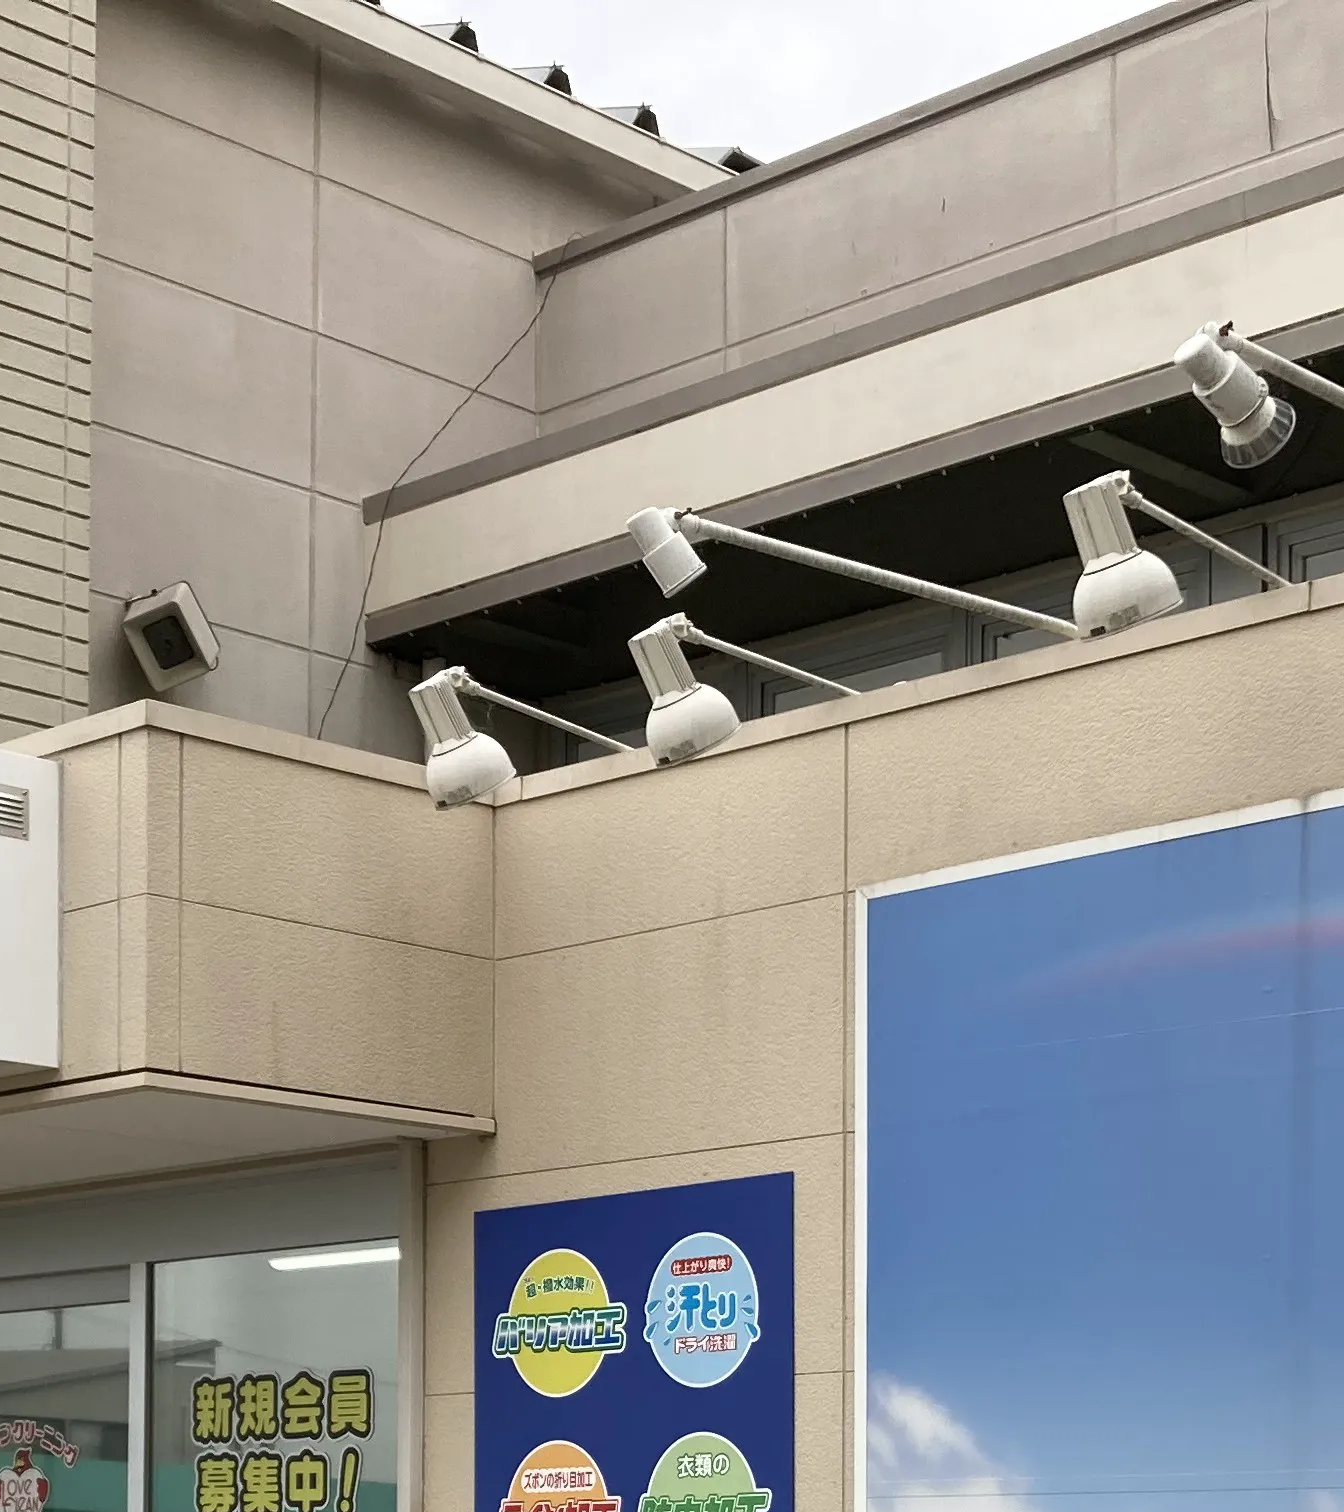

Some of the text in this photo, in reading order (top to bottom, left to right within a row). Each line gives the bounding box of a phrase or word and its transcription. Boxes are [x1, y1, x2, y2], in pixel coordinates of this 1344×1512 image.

[665, 1282, 737, 1332] 汗とり
[495, 1305, 625, 1356] バリア加工
[675, 1334, 737, 1354] ドライ洗濯
[192, 1368, 373, 1442] 新規会員
[524, 1471, 594, 1489] ズボンの折り目加工
[677, 1453, 730, 1478] 衣類の
